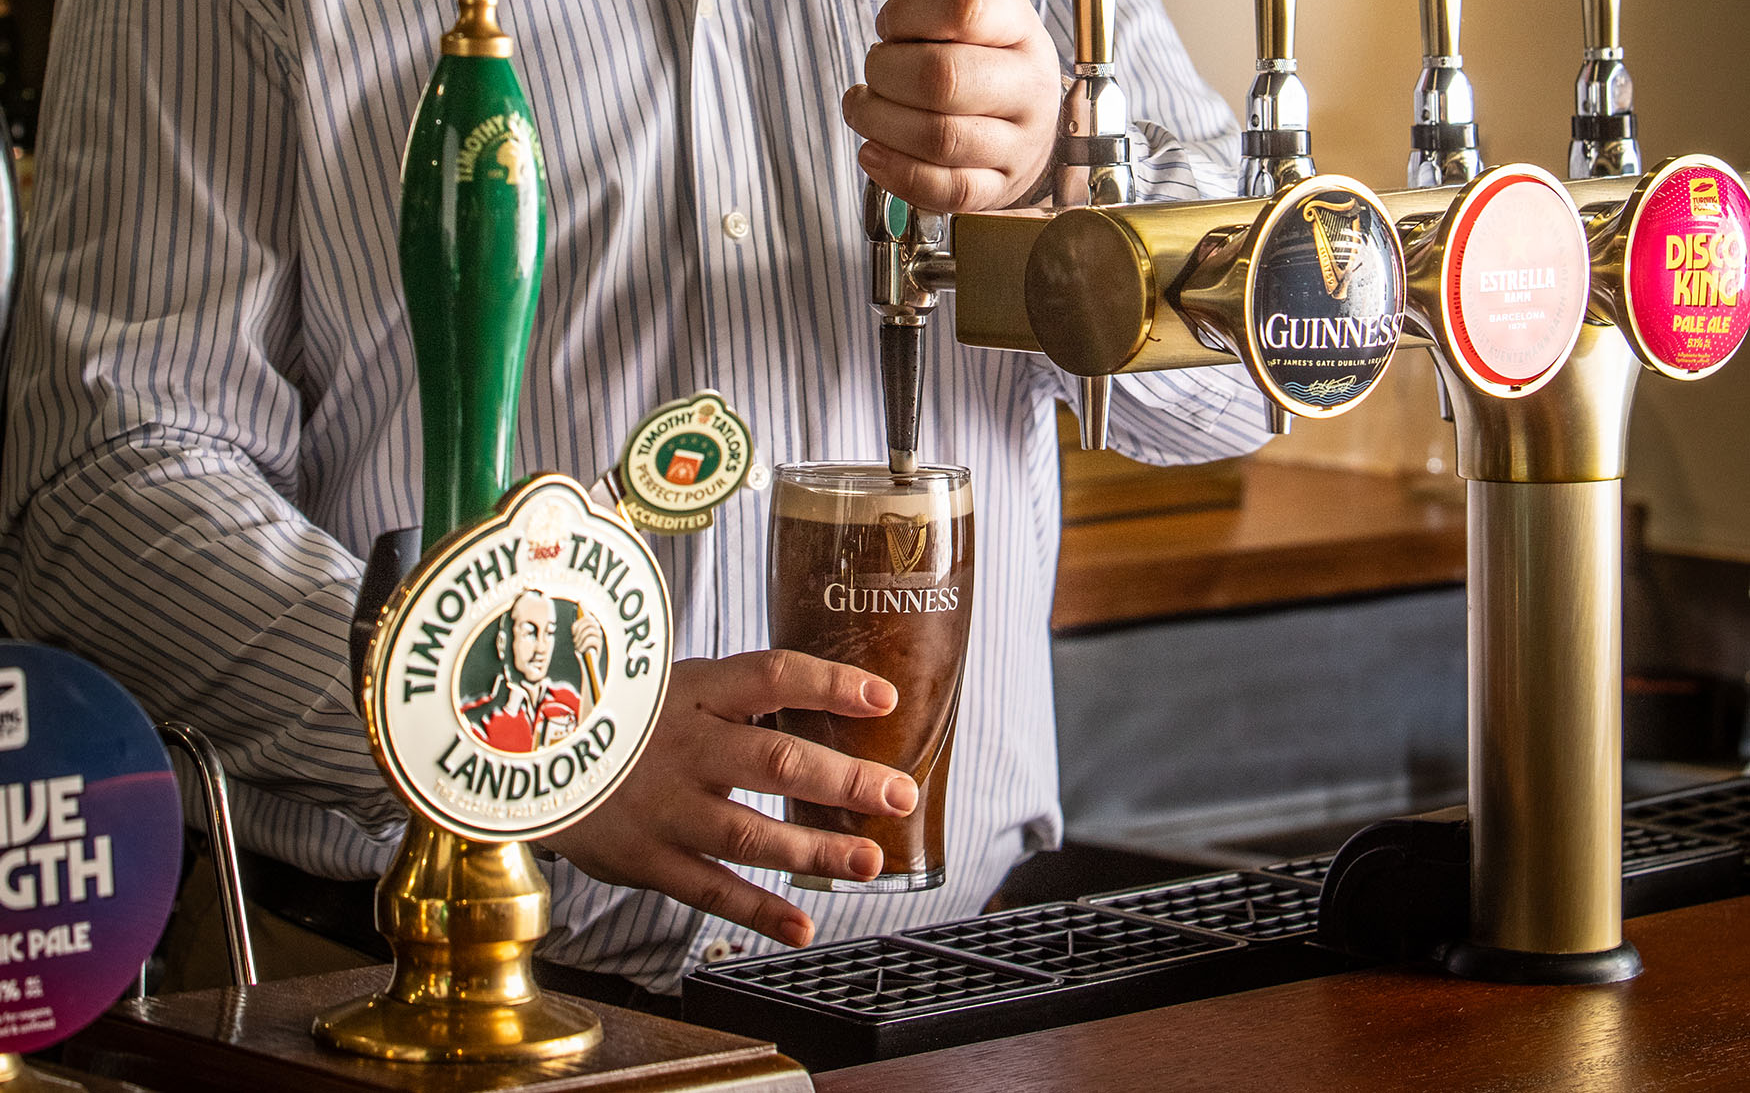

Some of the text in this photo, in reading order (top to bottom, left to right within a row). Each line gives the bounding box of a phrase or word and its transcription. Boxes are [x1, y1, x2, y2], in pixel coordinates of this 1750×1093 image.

[1665, 232, 1742, 270] DISCO
[1480, 268, 1555, 293] ESTRELLA
[1673, 270, 1739, 307] KING
[1265, 312, 1403, 350] GUINNESS
[1489, 311, 1546, 323] BARCELONA
[1672, 315, 1731, 334] PALE ALE
[1283, 359, 1313, 367] JAMES'S
[637, 410, 695, 456] TIMOTHY
[636, 463, 727, 503] PERFECT POUR
[626, 502, 709, 530] ACCREDITED
[823, 582, 960, 614] GUINNESS
[403, 533, 656, 703] TIMOTHY TAYLOR'S
[435, 715, 617, 802] LANDLORD
[27, 921, 92, 961] PALE
